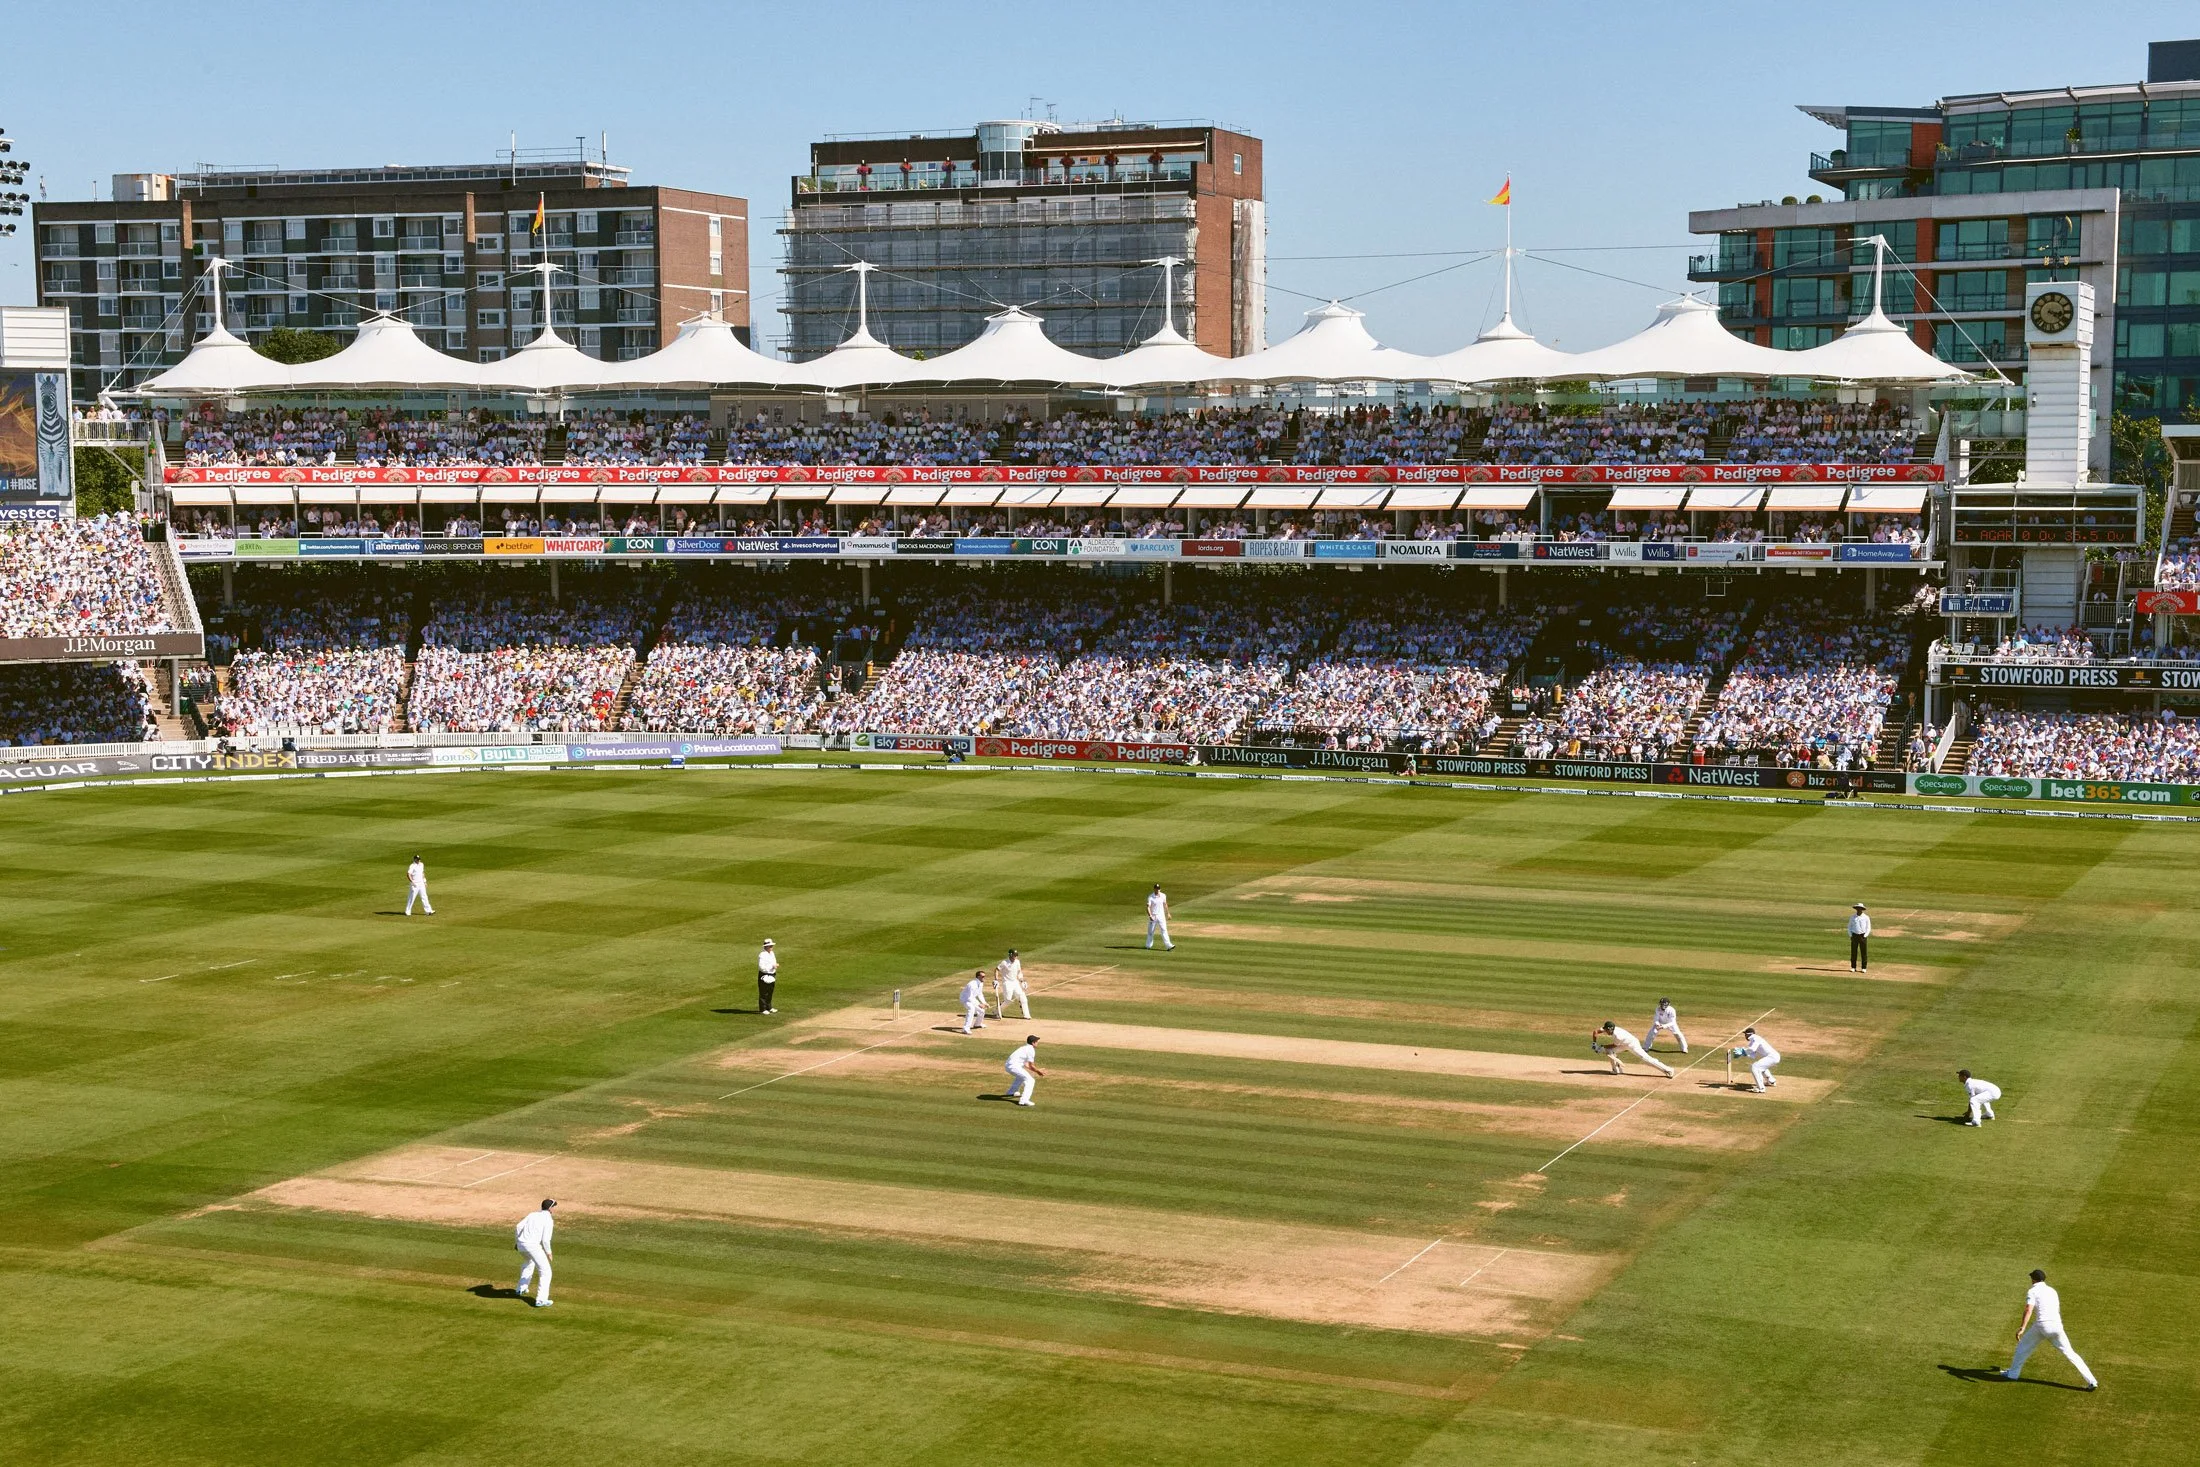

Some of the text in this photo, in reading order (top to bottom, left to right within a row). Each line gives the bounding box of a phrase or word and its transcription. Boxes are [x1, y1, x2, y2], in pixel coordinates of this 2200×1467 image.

[206, 469, 271, 483] Pedigree
[312, 469, 376, 483] Pedigree
[416, 469, 479, 483] Pedigree
[518, 469, 580, 483] Pedigree
[619, 469, 680, 483] Pedigree
[718, 469, 778, 482] Pedigree
[817, 469, 875, 482] Pedigree
[913, 468, 971, 482] Pedigree
[1010, 468, 1067, 482] Pedigree
[1104, 468, 1161, 482] Pedigree
[1199, 468, 1257, 482] Pedigree
[1296, 468, 1356, 482] Pedigree
[1397, 468, 1459, 482] Pedigree
[1500, 468, 1563, 482] Pedigree
[1606, 468, 1670, 482] Pedigree
[1714, 467, 1781, 482] Pedigree
[1826, 466, 1896, 482] Pedigree
[10, 478, 38, 490] #RISE
[1980, 530, 2013, 541] AGAR
[376, 542, 420, 551] alternative
[626, 540, 654, 550] ICON
[677, 541, 720, 550] SilverDoor
[737, 541, 779, 550] NatWest
[1032, 540, 1058, 550] ICON
[1390, 545, 1441, 555] NOMURA
[1549, 546, 1595, 557] NatWest
[1615, 546, 1636, 557] Willis
[1648, 547, 1670, 558] Willis
[64, 638, 156, 656] J.P.Morgan
[1980, 667, 2118, 686] STOWFORD PRESS
[694, 743, 776, 754] PrimeLocation.com
[876, 737, 895, 750] sky
[954, 740, 968, 750] HD
[1011, 742, 1077, 758] Pedigree
[297, 754, 382, 764] FIRED EARTH
[484, 748, 527, 760] BUILD
[586, 748, 671, 757] PrimeLocation.com
[1117, 746, 1184, 762] Pedigree
[1210, 748, 1288, 768] J.P.Morgan
[1310, 752, 1389, 772] J.P.Morgan
[1436, 760, 1527, 775] STOWFORD PRESS
[1554, 764, 1648, 780] STOWFORD PRESS
[1689, 768, 1760, 786] NatWest
[1919, 778, 1962, 790] Specsavers
[1984, 782, 2028, 792] Specsavers
[2050, 783, 2171, 802] bet365.com
